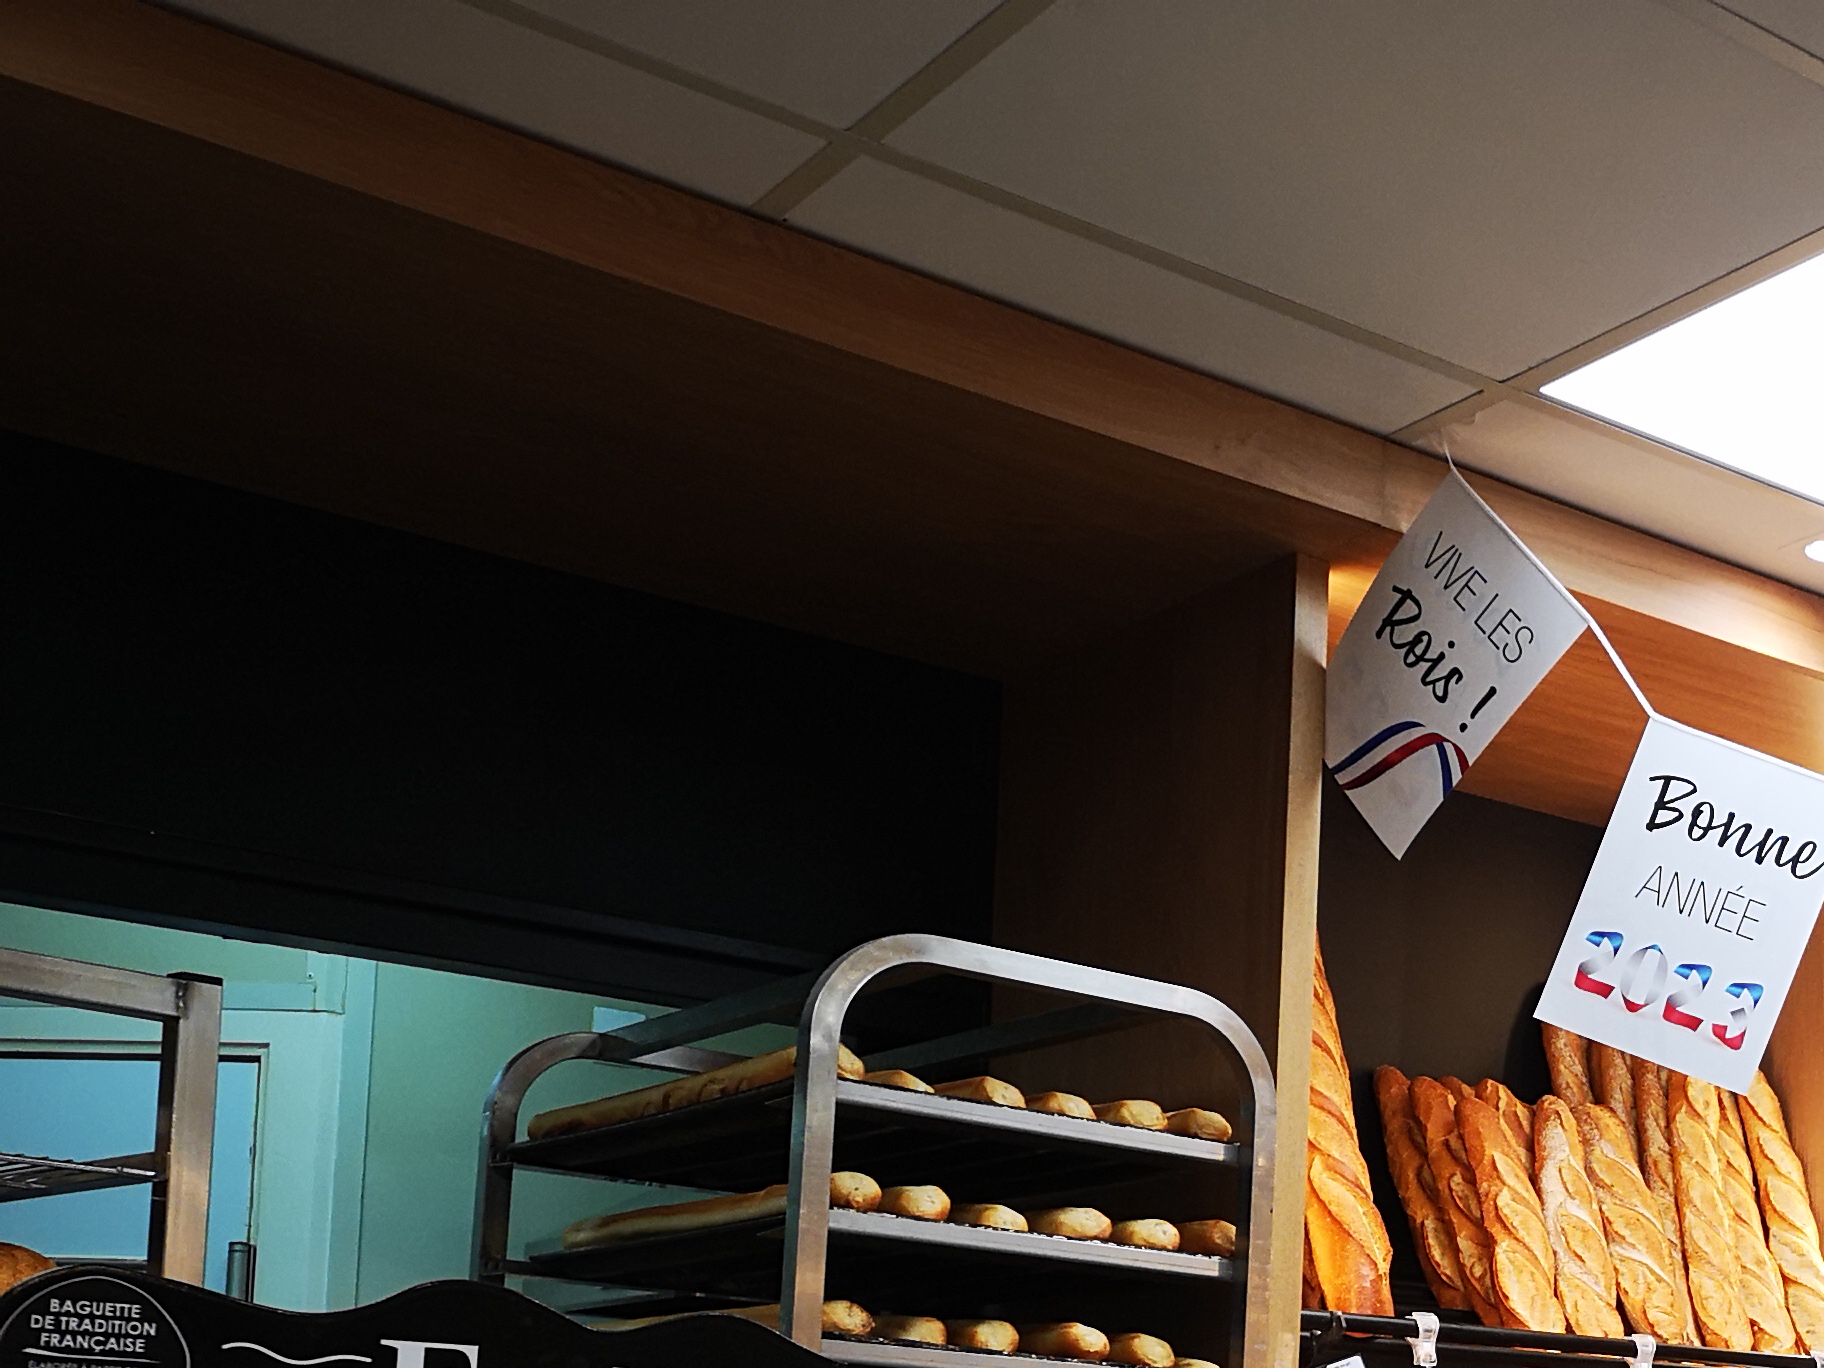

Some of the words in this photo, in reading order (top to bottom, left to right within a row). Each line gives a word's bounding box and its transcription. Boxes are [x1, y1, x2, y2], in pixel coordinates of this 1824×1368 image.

[1424, 531, 1487, 612] VIVE
[1473, 593, 1534, 663] LES
[1375, 585, 1463, 703] Rois
[1458, 686, 1497, 732] !
[1635, 864, 1767, 941] ANNÉE
[1574, 930, 1764, 1051] 2023
[30, 1315, 55, 1330] DE
[60, 1317, 157, 1336] TRADITION
[40, 1333, 145, 1352] FRANÇAISE
[50, 1299, 142, 1318] BAGUETTE
